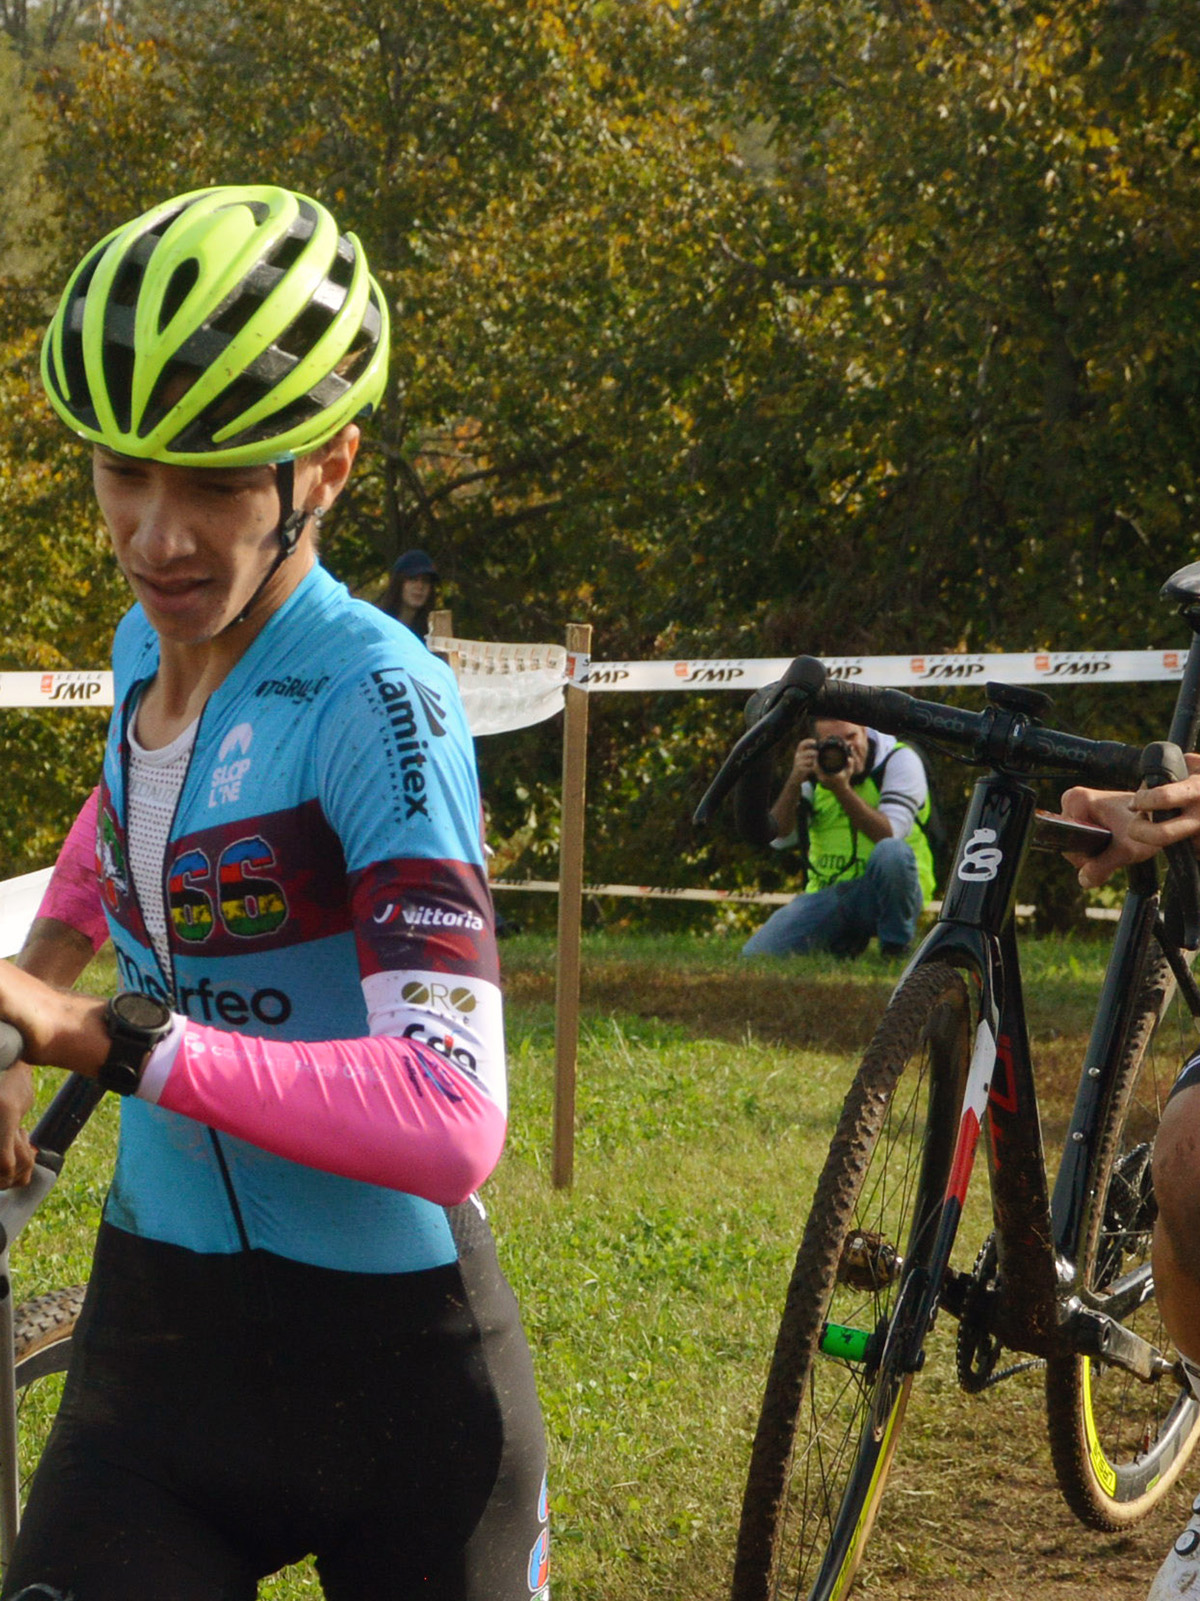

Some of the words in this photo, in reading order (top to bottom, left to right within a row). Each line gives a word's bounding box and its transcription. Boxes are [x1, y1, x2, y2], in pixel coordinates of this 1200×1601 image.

[683, 667, 745, 683] SMP
[918, 663, 985, 679] SMP
[1043, 661, 1112, 677] SMP
[49, 682, 102, 700] SMP
[370, 667, 429, 820] Lamitex
[168, 837, 289, 944] 66
[402, 906, 484, 931] vittoria
